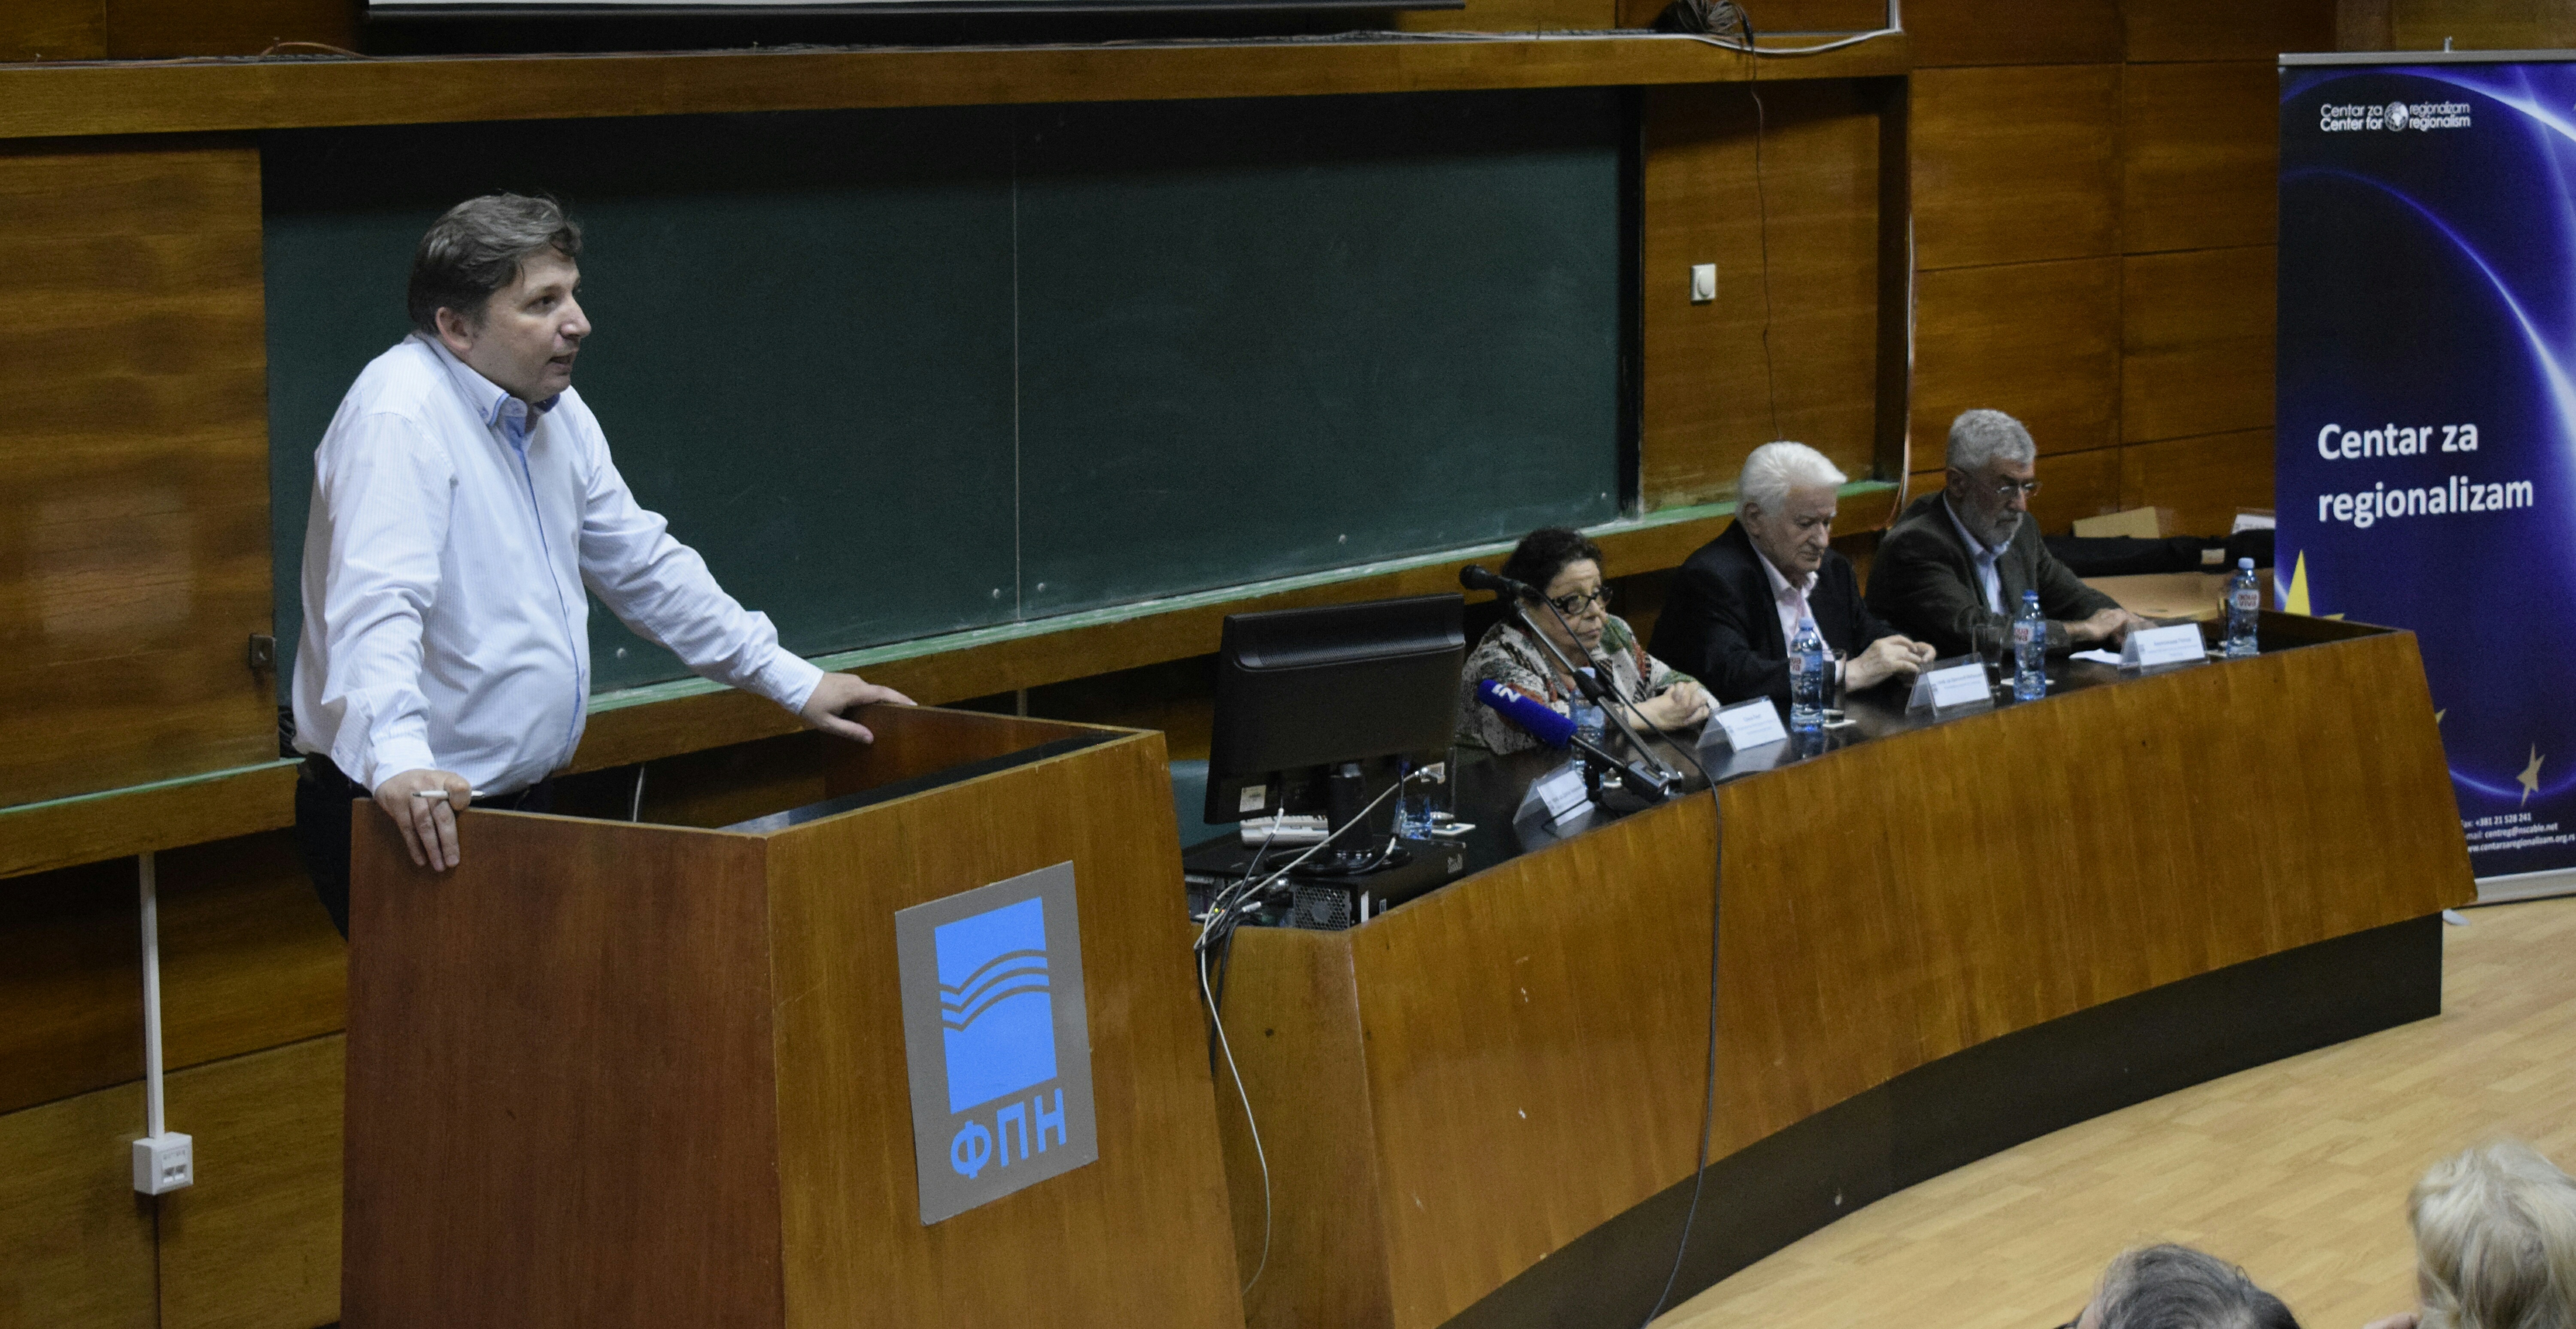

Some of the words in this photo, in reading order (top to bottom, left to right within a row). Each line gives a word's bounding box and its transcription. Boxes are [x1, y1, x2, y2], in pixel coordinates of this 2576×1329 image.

[2321, 103, 2364, 118] Centar
[2367, 105, 2384, 116] za
[2409, 101, 2471, 117] regionalizam
[2320, 117, 2364, 132] Center
[2366, 116, 2384, 130] for
[2409, 115, 2471, 132] regionalism
[2318, 422, 2433, 460] Centar
[2441, 423, 2478, 452] za
[2318, 475, 2533, 528] regionalizam
[2494, 815, 2503, 825] 21
[2518, 812, 2531, 822] 241
[950, 1087, 1067, 1180] ФПН
